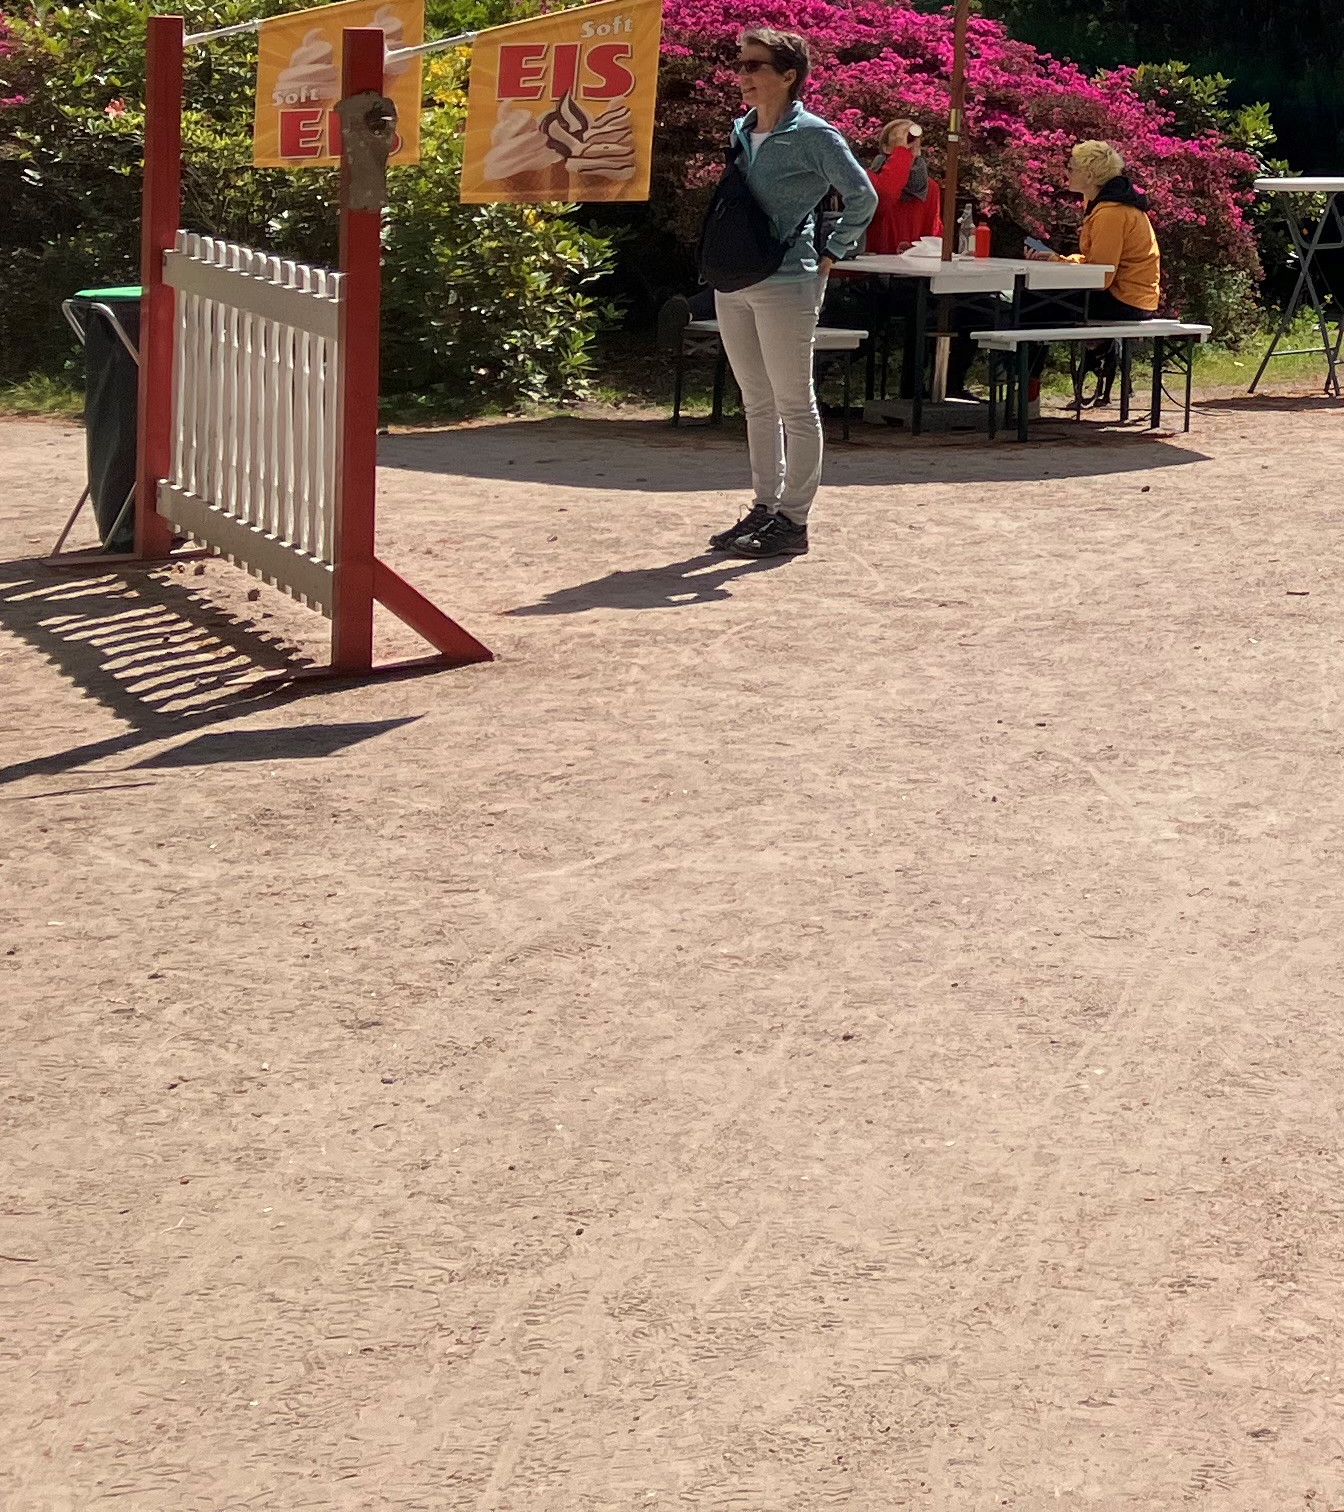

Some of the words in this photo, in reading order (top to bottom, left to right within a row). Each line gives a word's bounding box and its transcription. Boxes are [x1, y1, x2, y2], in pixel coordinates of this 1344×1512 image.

[581, 14, 633, 38] Soft
[497, 42, 635, 101] EIS
[271, 85, 320, 107] Soft
[278, 108, 402, 159] EI
